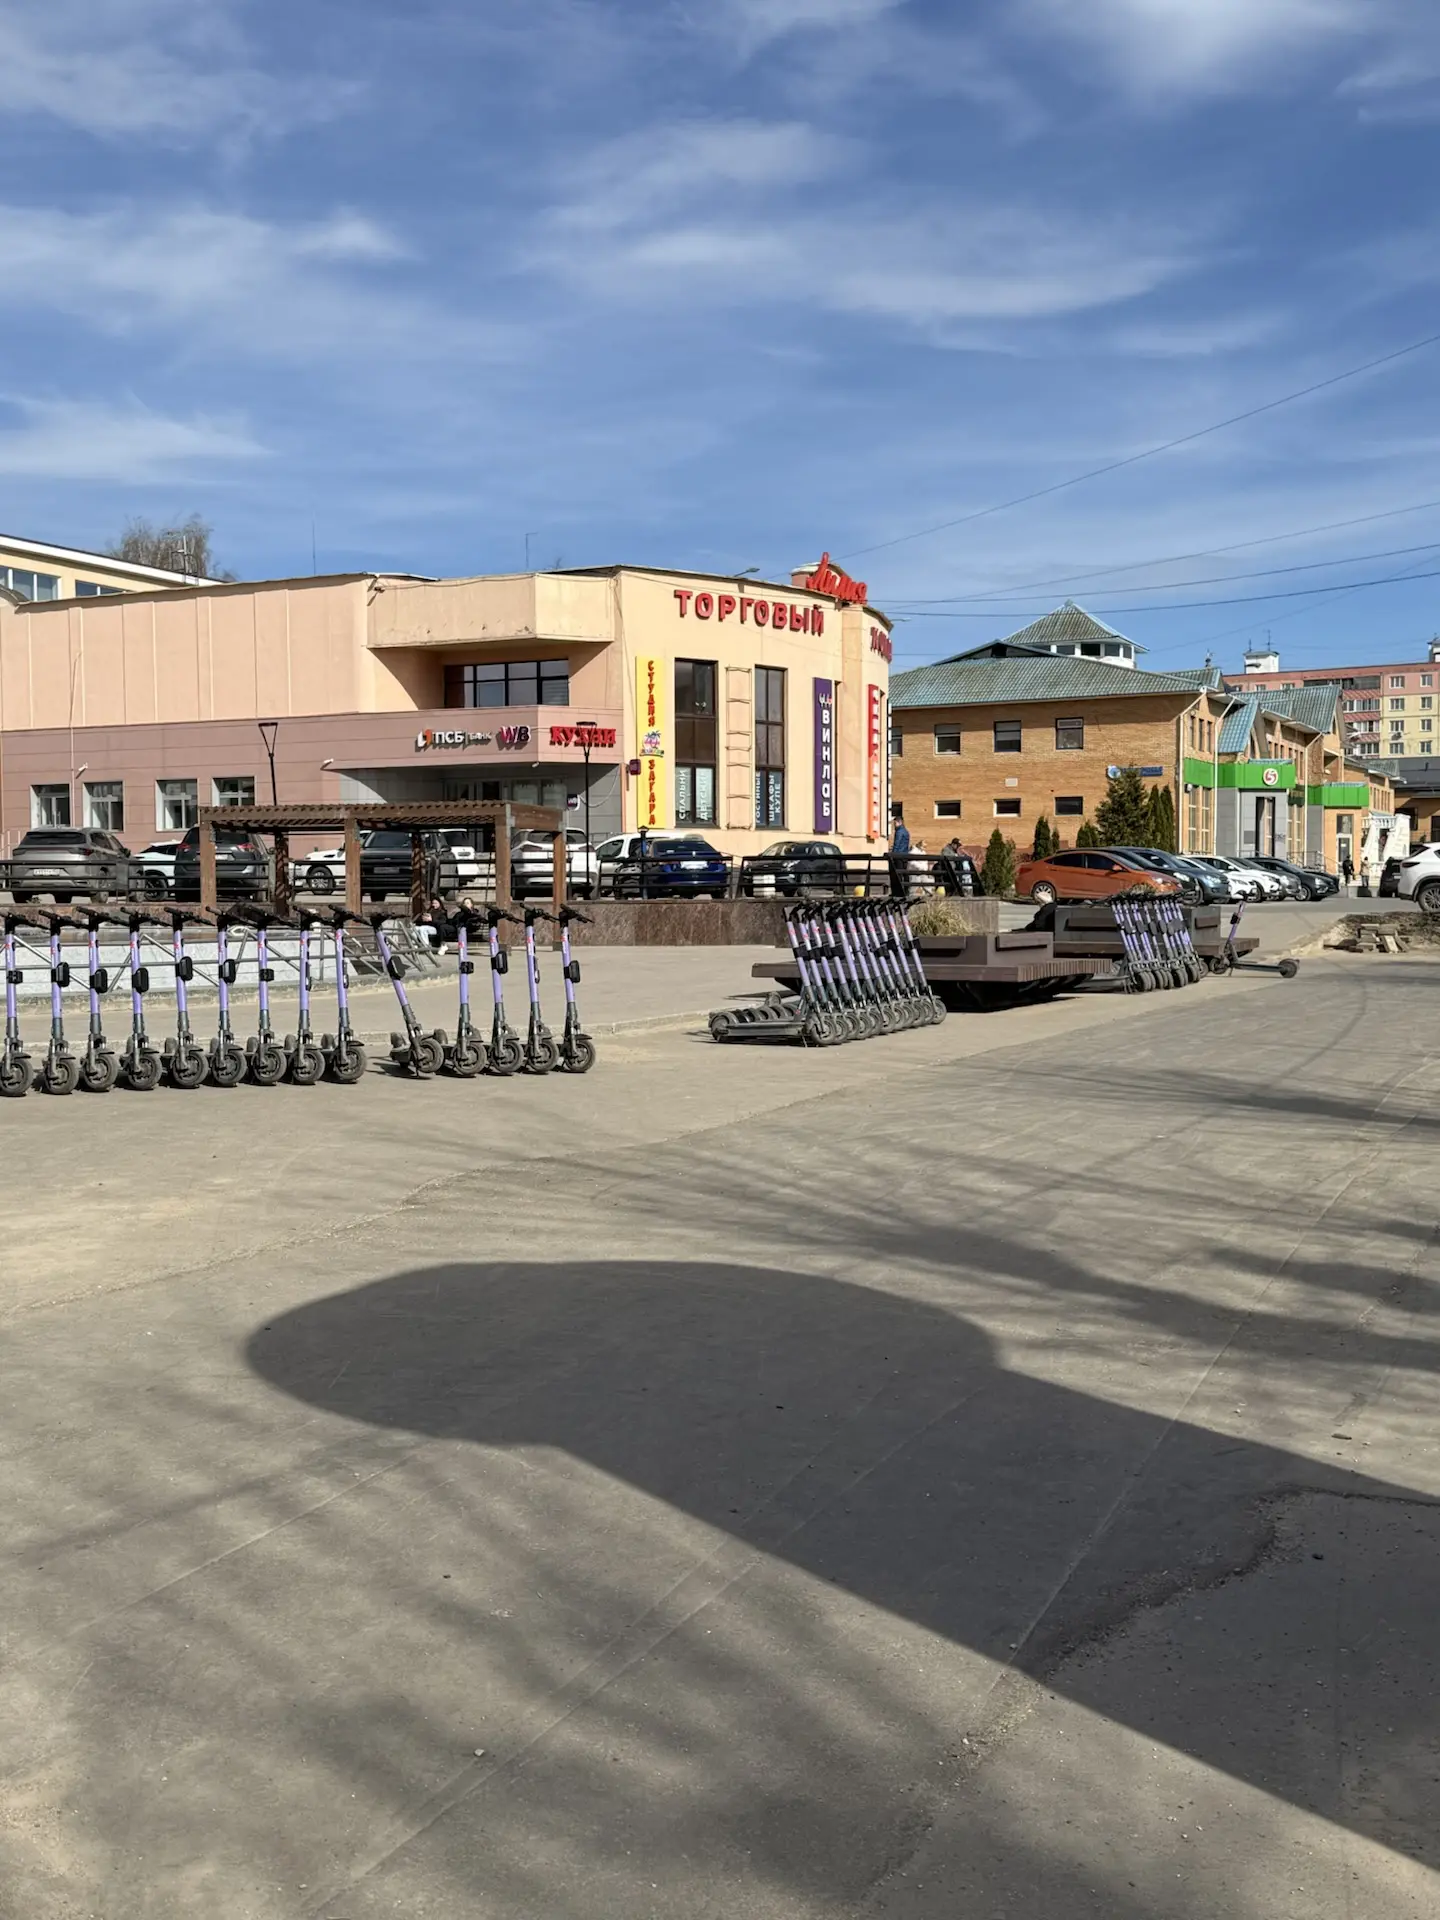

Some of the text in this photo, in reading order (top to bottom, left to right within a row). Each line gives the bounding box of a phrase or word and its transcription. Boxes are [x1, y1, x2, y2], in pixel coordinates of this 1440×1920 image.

[674, 589, 825, 637] ТОРГОВЫЙ
[647, 660, 655, 727] СТУДИЯ
[435, 731, 465, 744] ПСБ
[500, 725, 531, 744] WB
[648, 759, 656, 825] ЗАГАРА
[678, 769, 687, 820] СПАЛЬНИ
